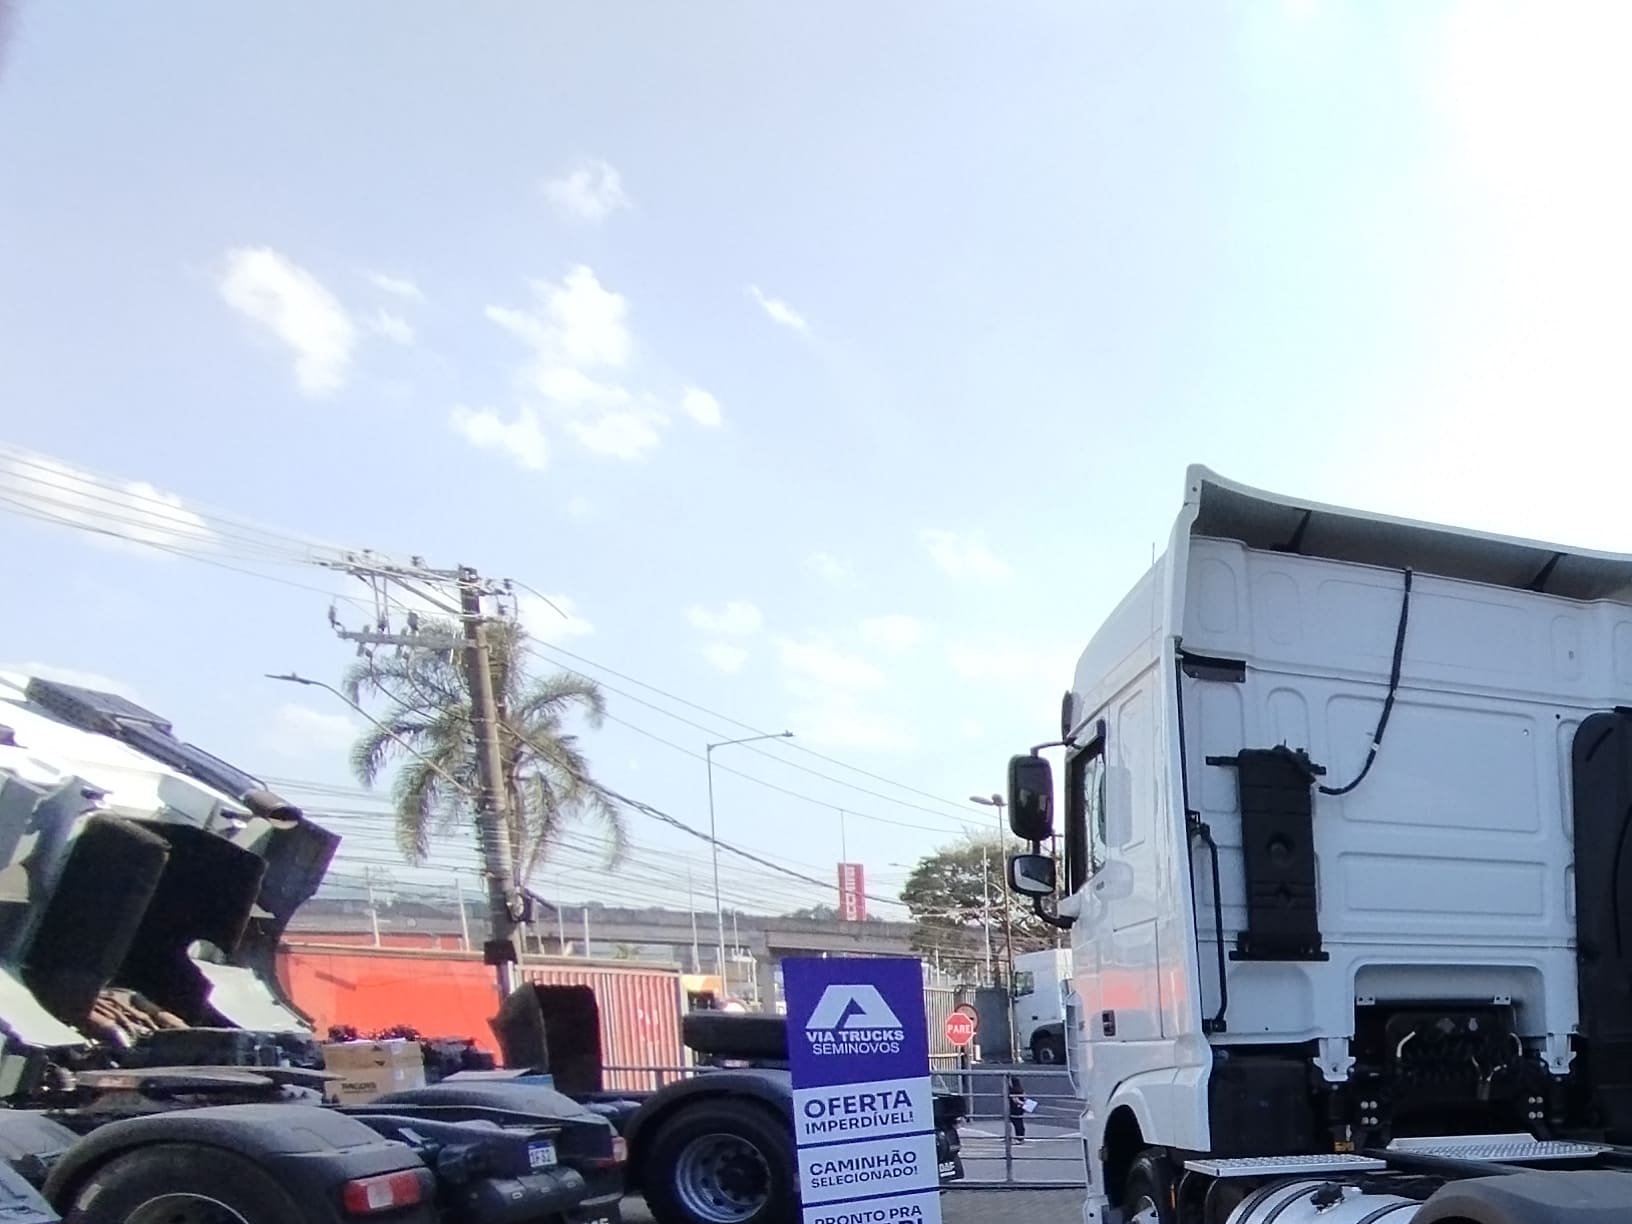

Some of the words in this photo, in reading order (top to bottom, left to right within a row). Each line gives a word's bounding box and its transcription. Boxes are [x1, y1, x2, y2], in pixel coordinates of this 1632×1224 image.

[806, 1031, 835, 1043] VIA
[839, 1030, 904, 1042] TRUCKS
[947, 1024, 971, 1034] PARE
[812, 1042, 900, 1055] SEMINOVOS
[804, 1089, 913, 1119] OFERTA
[805, 1111, 914, 1135] IMPERDÍVEL!
[809, 1150, 917, 1176] CAMINHÃO
[811, 1165, 918, 1189] SELECIONADO!
[889, 1205, 922, 1219] PRA
